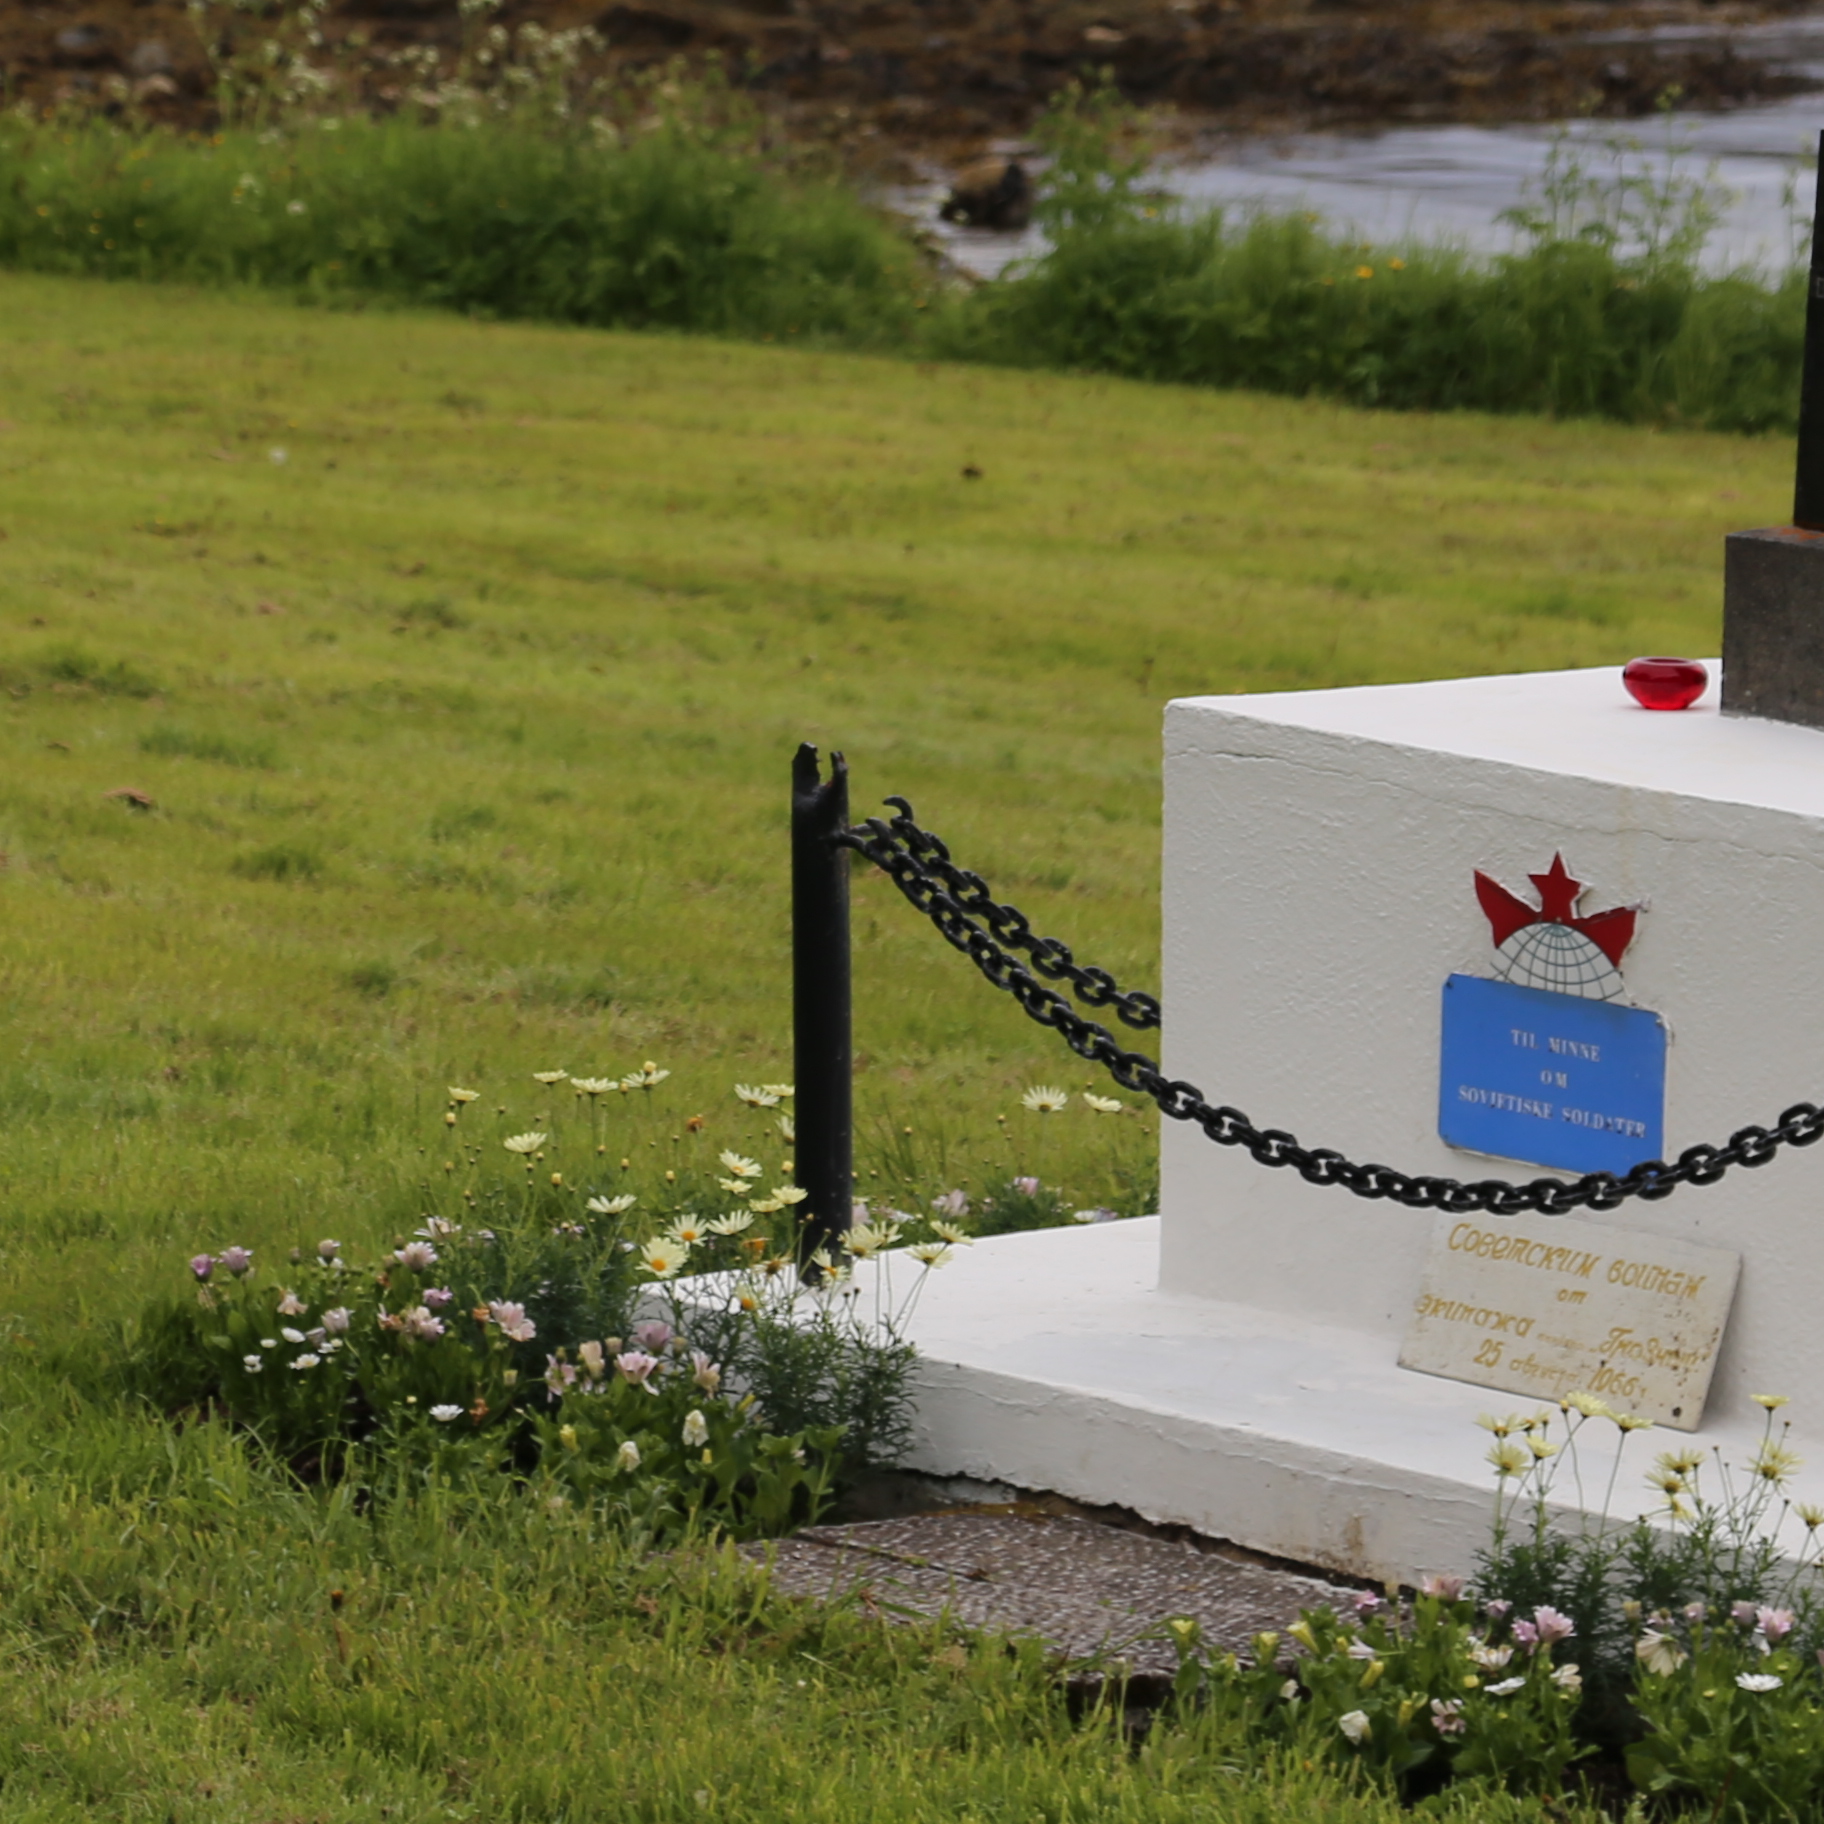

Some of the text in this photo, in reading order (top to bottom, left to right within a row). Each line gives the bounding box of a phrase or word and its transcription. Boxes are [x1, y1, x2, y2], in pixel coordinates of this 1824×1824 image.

[1510, 1029, 1601, 1063] TIL MINNE
[1540, 1069, 1569, 1089] OM
[1458, 1084, 1647, 1139] SOVJETISKE SOLDATER
[1447, 1222, 1602, 1279] Советским
[1557, 1288, 1589, 1305] от
[1473, 1338, 1505, 1367] 25
